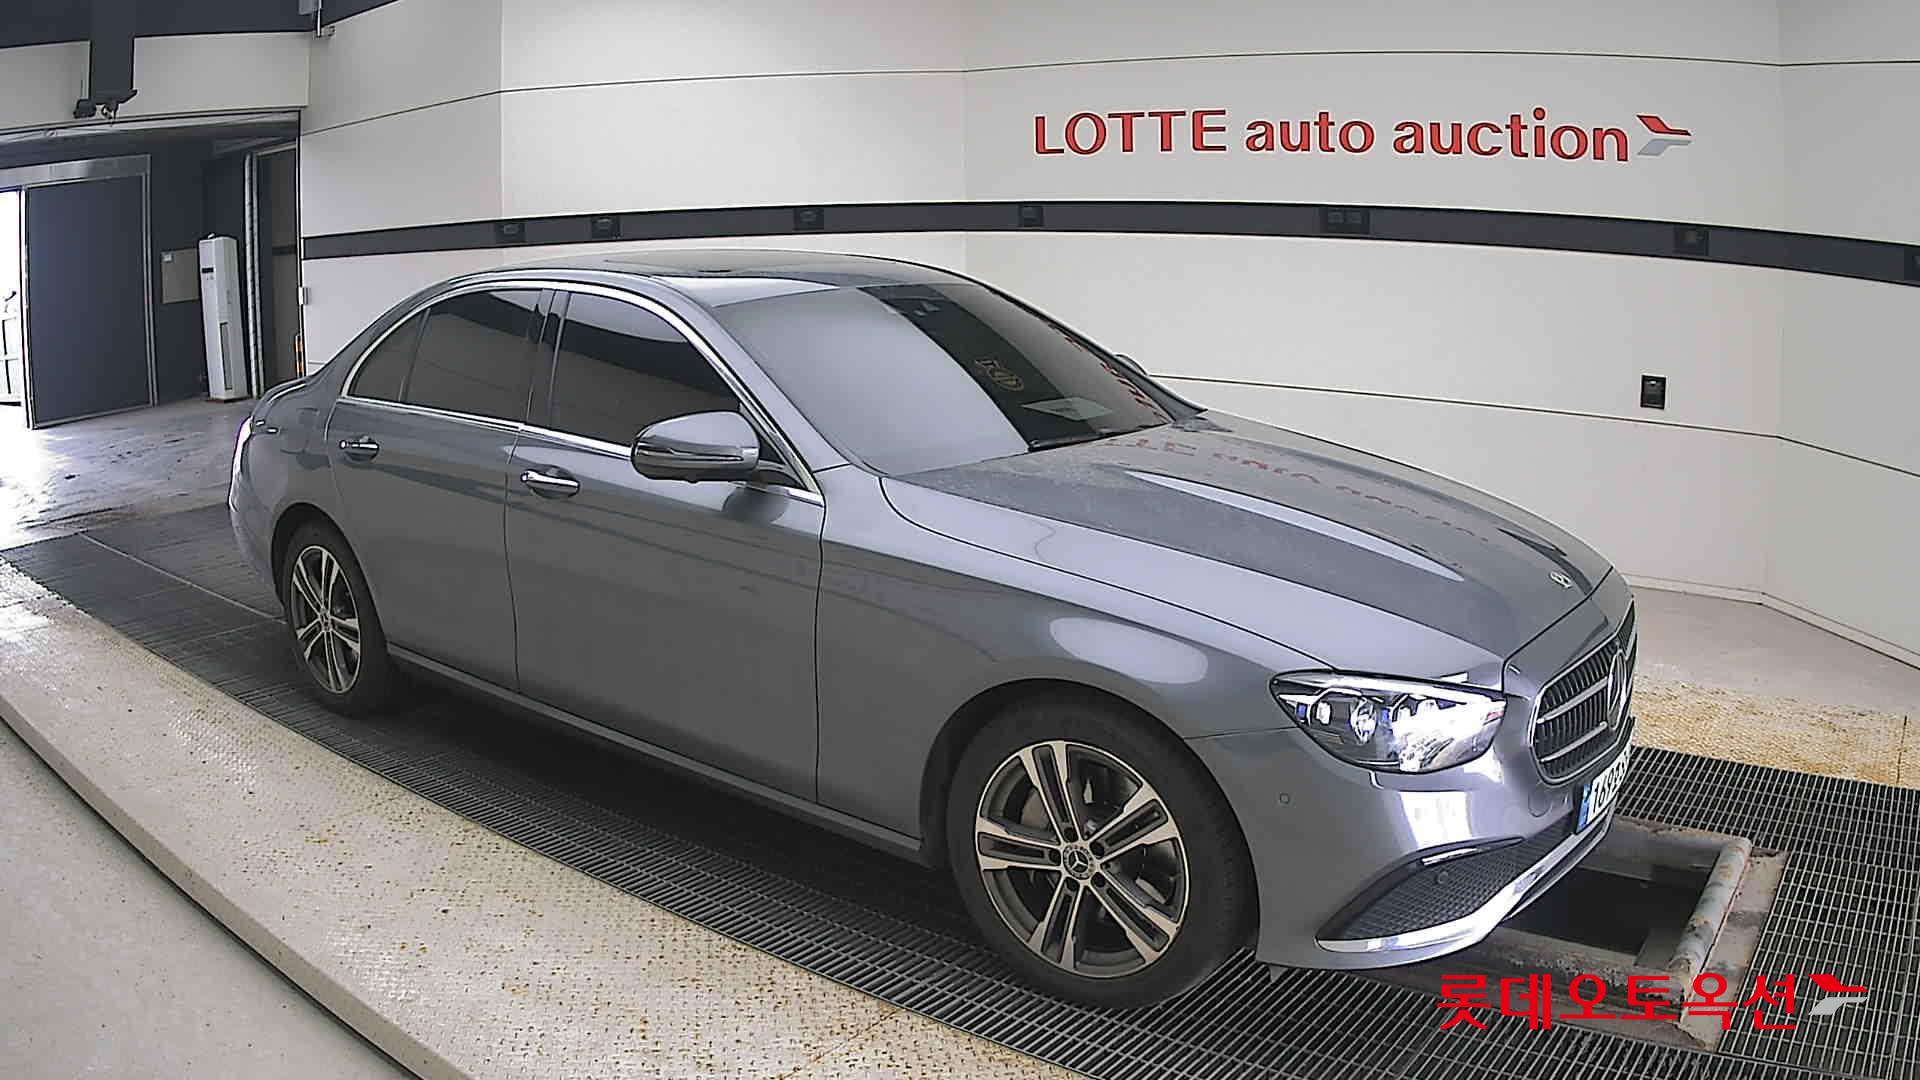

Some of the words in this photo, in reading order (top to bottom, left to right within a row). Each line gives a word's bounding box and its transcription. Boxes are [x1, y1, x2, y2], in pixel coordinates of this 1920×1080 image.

[1034, 110, 1227, 155] LOTTE
[1245, 111, 1375, 153] auto
[1392, 107, 1629, 162] auction
